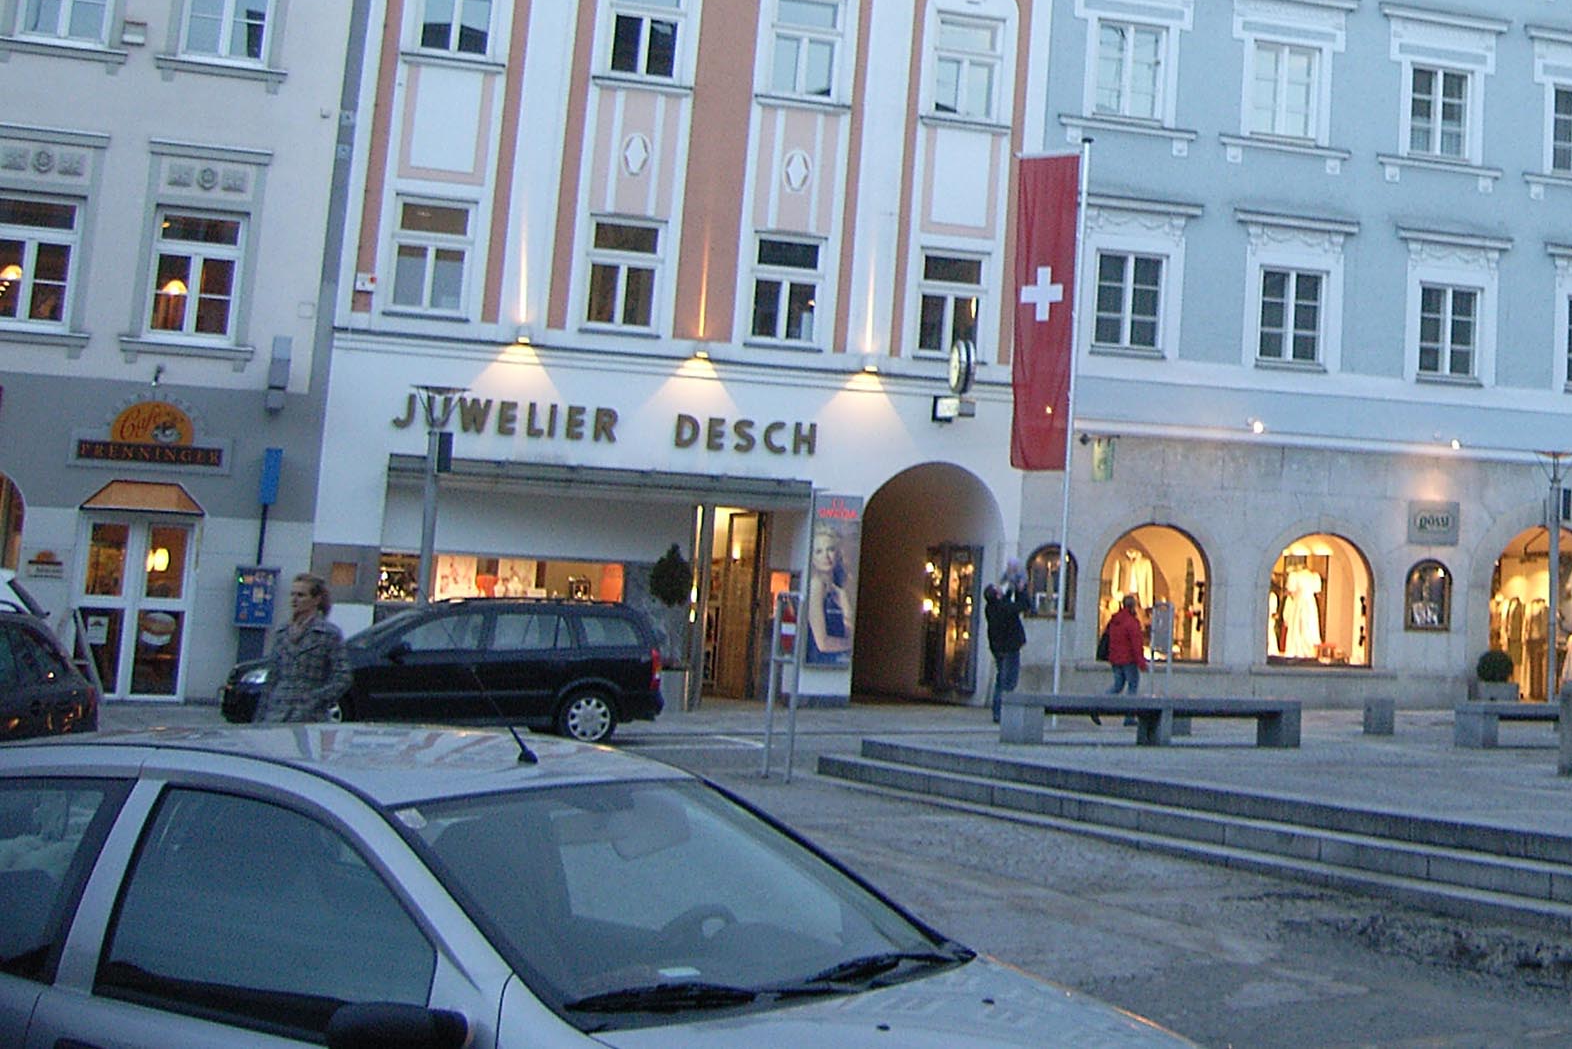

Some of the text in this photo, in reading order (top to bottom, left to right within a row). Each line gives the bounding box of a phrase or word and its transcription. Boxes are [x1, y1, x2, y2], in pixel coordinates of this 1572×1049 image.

[392, 392, 818, 456] JUWELIER DESCH
[79, 443, 221, 465] PRENNINGER
